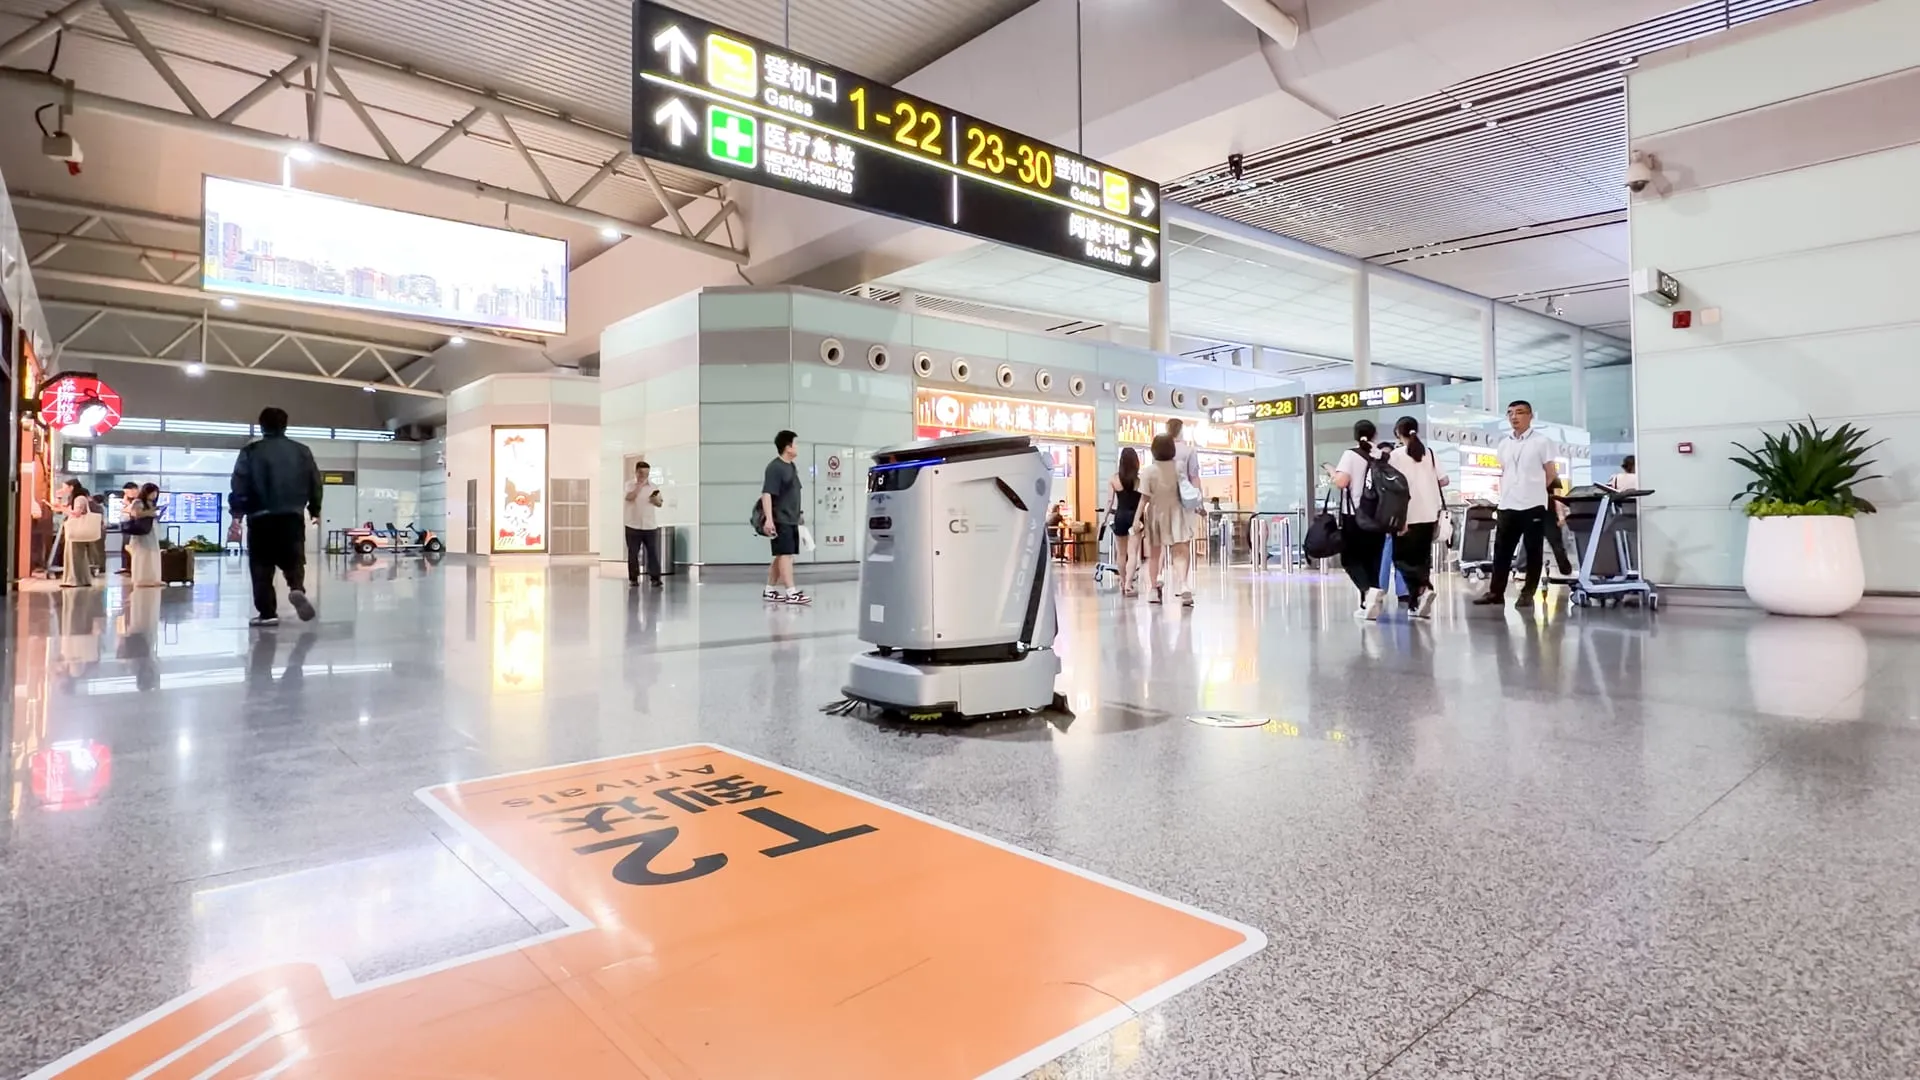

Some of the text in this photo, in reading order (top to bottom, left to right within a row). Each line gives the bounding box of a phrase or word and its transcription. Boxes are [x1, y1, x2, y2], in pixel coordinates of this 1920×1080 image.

[764, 54, 837, 103] 登机口
[764, 88, 814, 117] Gates
[849, 87, 942, 156] 1-22
[764, 121, 855, 171] 医疗急救
[967, 128, 1053, 189] 23-30
[764, 149, 853, 184] MEDICAL FIRST AID
[1054, 154, 1100, 190] 登机口
[1070, 186, 1101, 208] Gates
[1069, 212, 1131, 250] 阅读书吧
[1086, 240, 1132, 266] Book bar
[1255, 400, 1293, 418] 23-28
[1317, 393, 1359, 410] 29-30
[948, 519, 969, 534] C5
[502, 763, 716, 808] Arrivals
[527, 774, 783, 835] 到达
